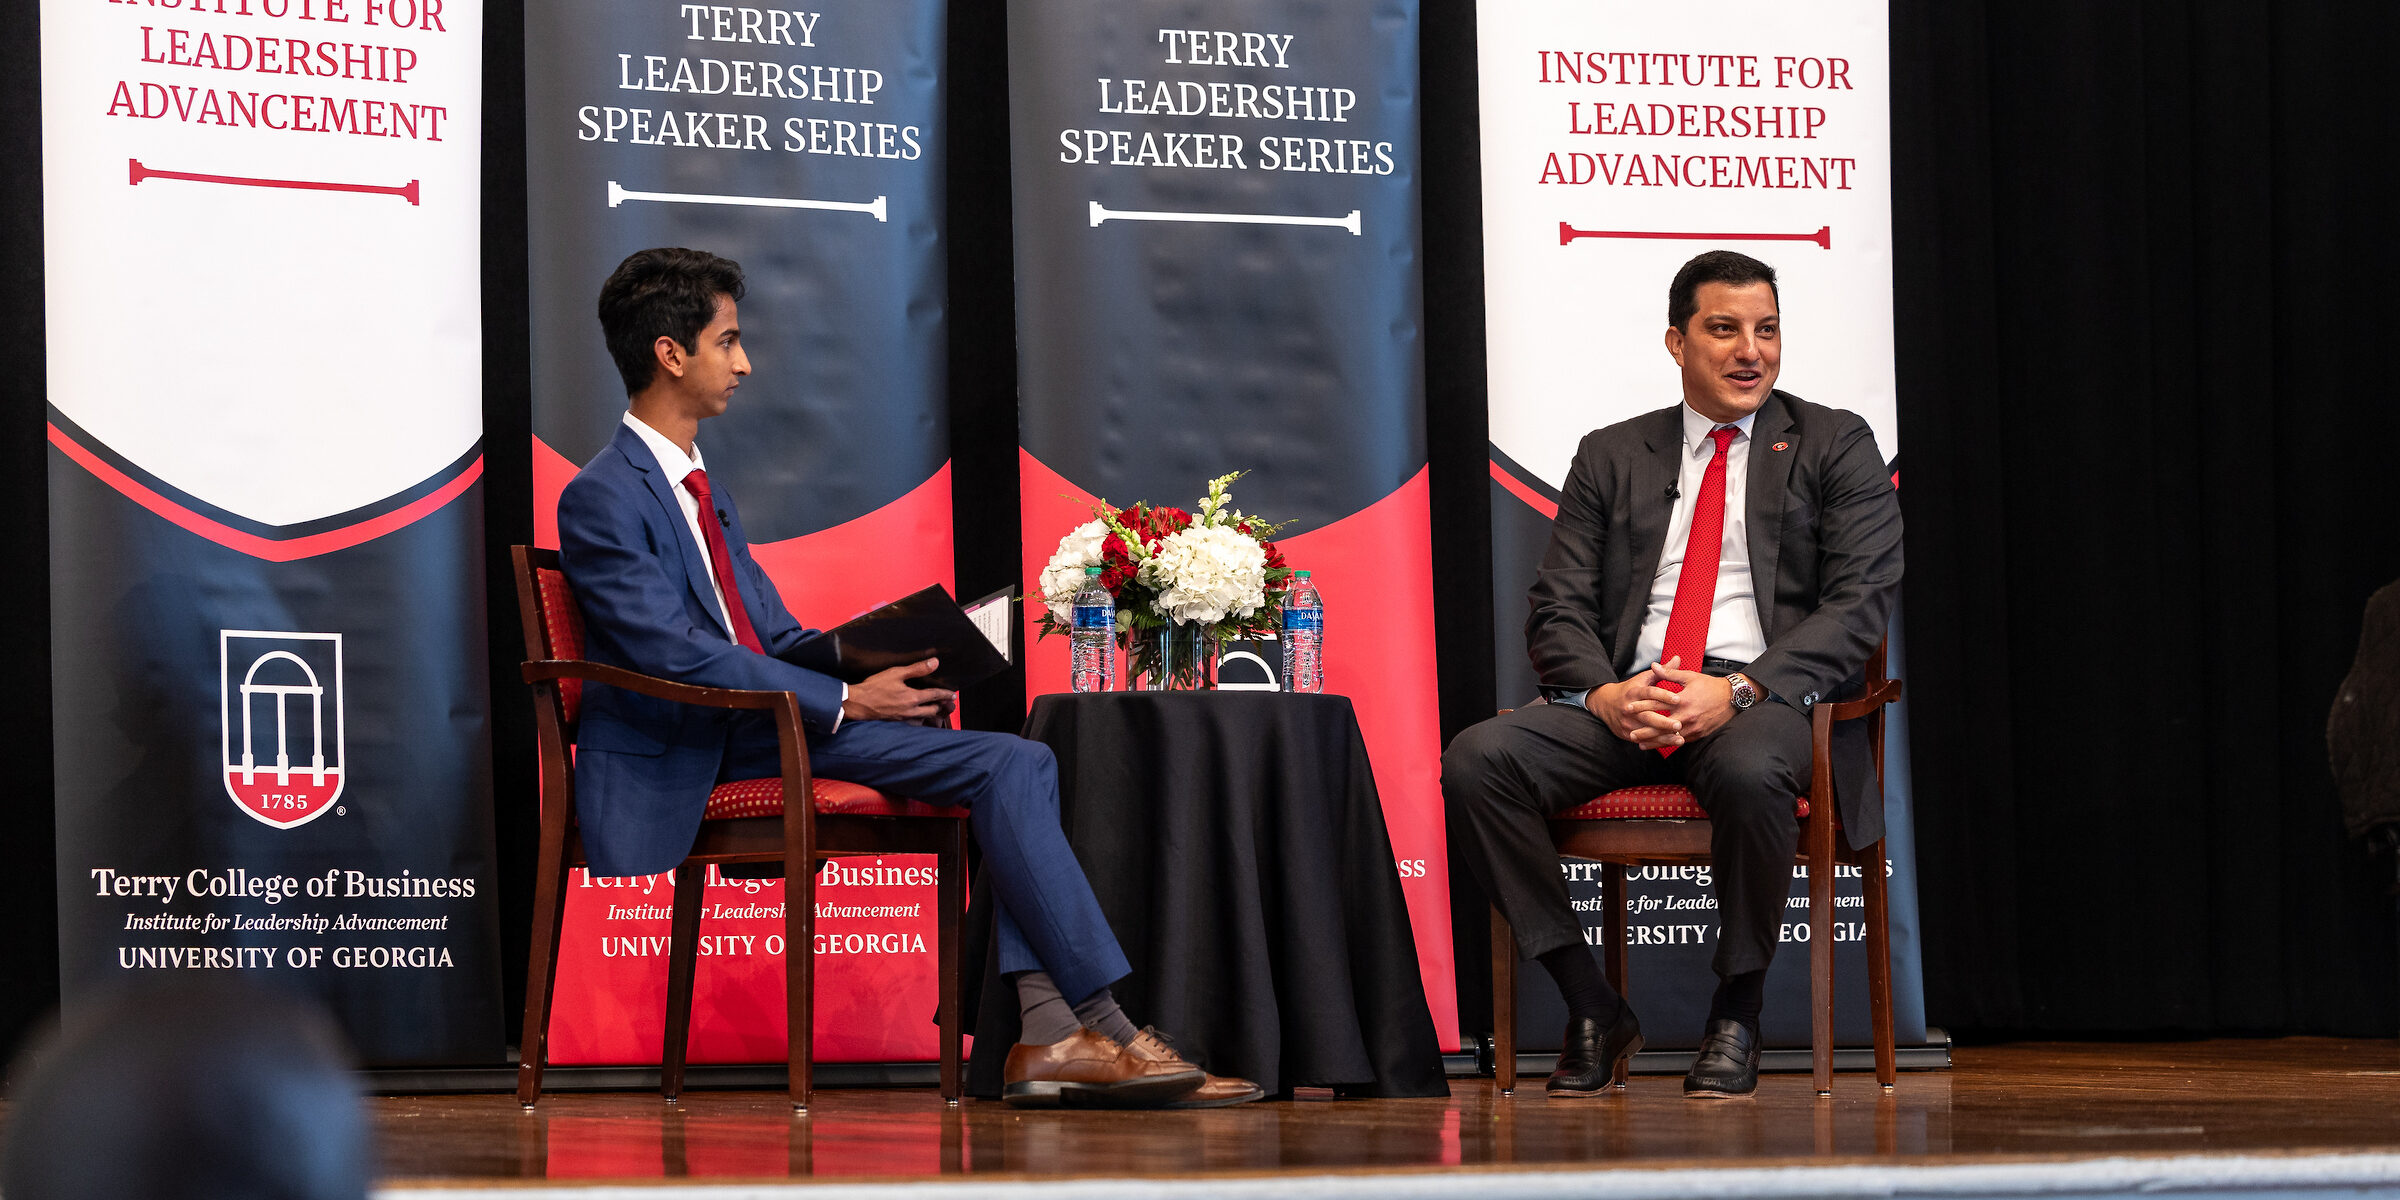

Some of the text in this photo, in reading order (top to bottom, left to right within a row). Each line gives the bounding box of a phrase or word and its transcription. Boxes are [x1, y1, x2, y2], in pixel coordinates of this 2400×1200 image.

[364, 0, 446, 32] FOR
[681, 4, 820, 47] TERRY
[140, 26, 417, 84] LEADERSHIP
[1159, 29, 1293, 68] TERRY
[618, 54, 883, 104] LEADERSHIP
[1538, 51, 1853, 90] INSTITUTE FOR
[107, 80, 447, 142] ADVANCEMENT
[1098, 79, 1356, 122] LEADERSHIP
[578, 106, 922, 160] SPEAKER SERIES
[1568, 102, 1826, 139] LEADERSHIP
[1060, 129, 1395, 175] SPEAKER SERIES
[1538, 152, 1856, 190] ADVANCEMENT
[261, 794, 308, 810] 1785
[91, 869, 476, 904] Terry College of Business
[1634, 895, 1662, 914] for
[124, 913, 448, 934] Institute for Leadership Advancement
[607, 904, 672, 920] Institut
[712, 903, 786, 919] Leadersh
[119, 947, 454, 969] UNIVERSITY OF GEORGIA
[602, 935, 756, 957] UNIVSITY
[813, 933, 927, 955] GEORGIA
